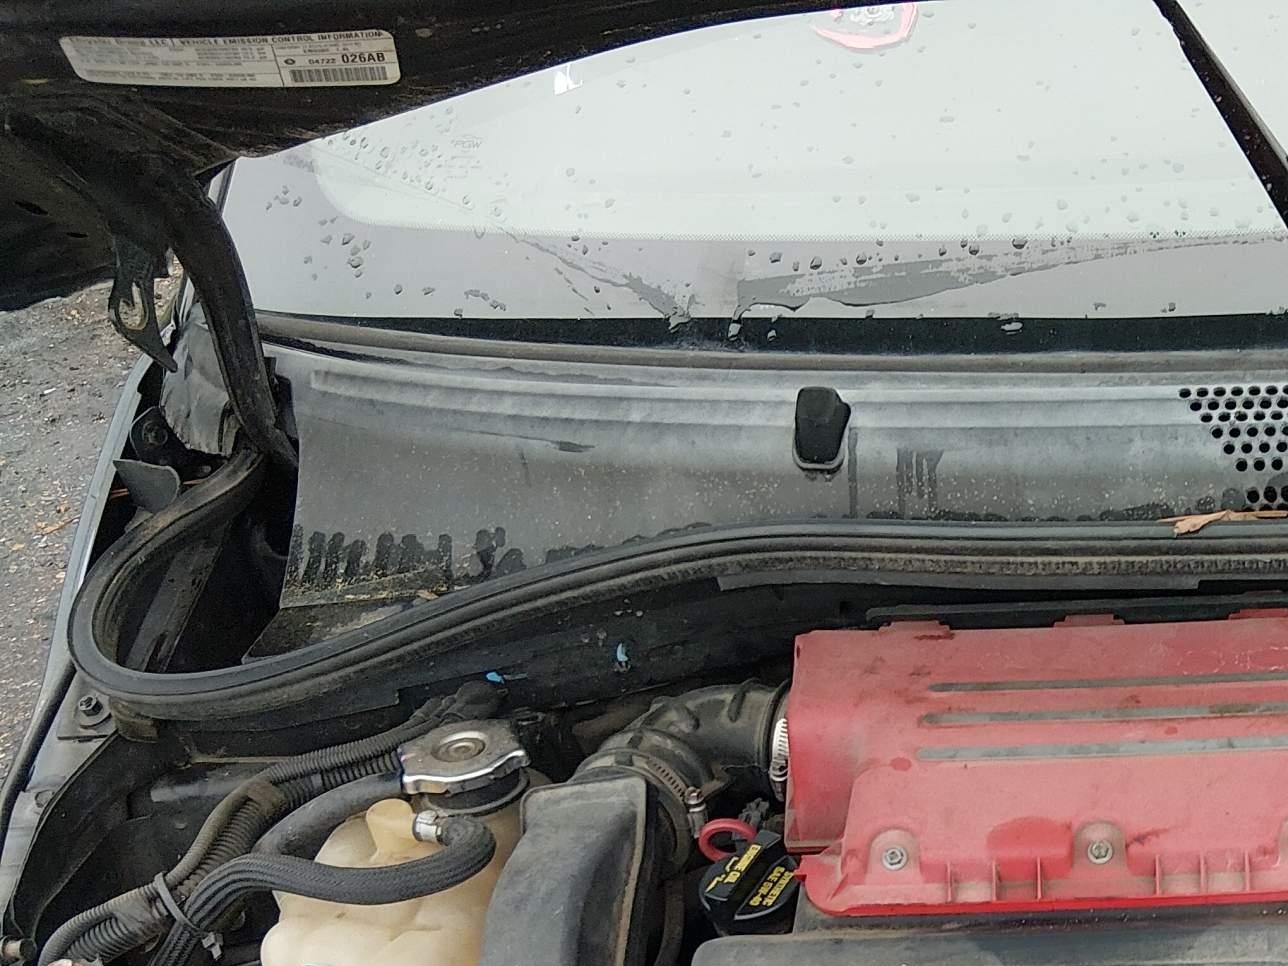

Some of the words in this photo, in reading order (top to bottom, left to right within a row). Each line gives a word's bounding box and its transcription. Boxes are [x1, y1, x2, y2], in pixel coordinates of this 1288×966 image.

[180, 37, 218, 46] VEHICLE
[222, 36, 268, 45] EMISSION
[271, 35, 314, 44] CONTROL
[317, 31, 383, 41] INFORMATION
[341, 52, 386, 63] 026AB
